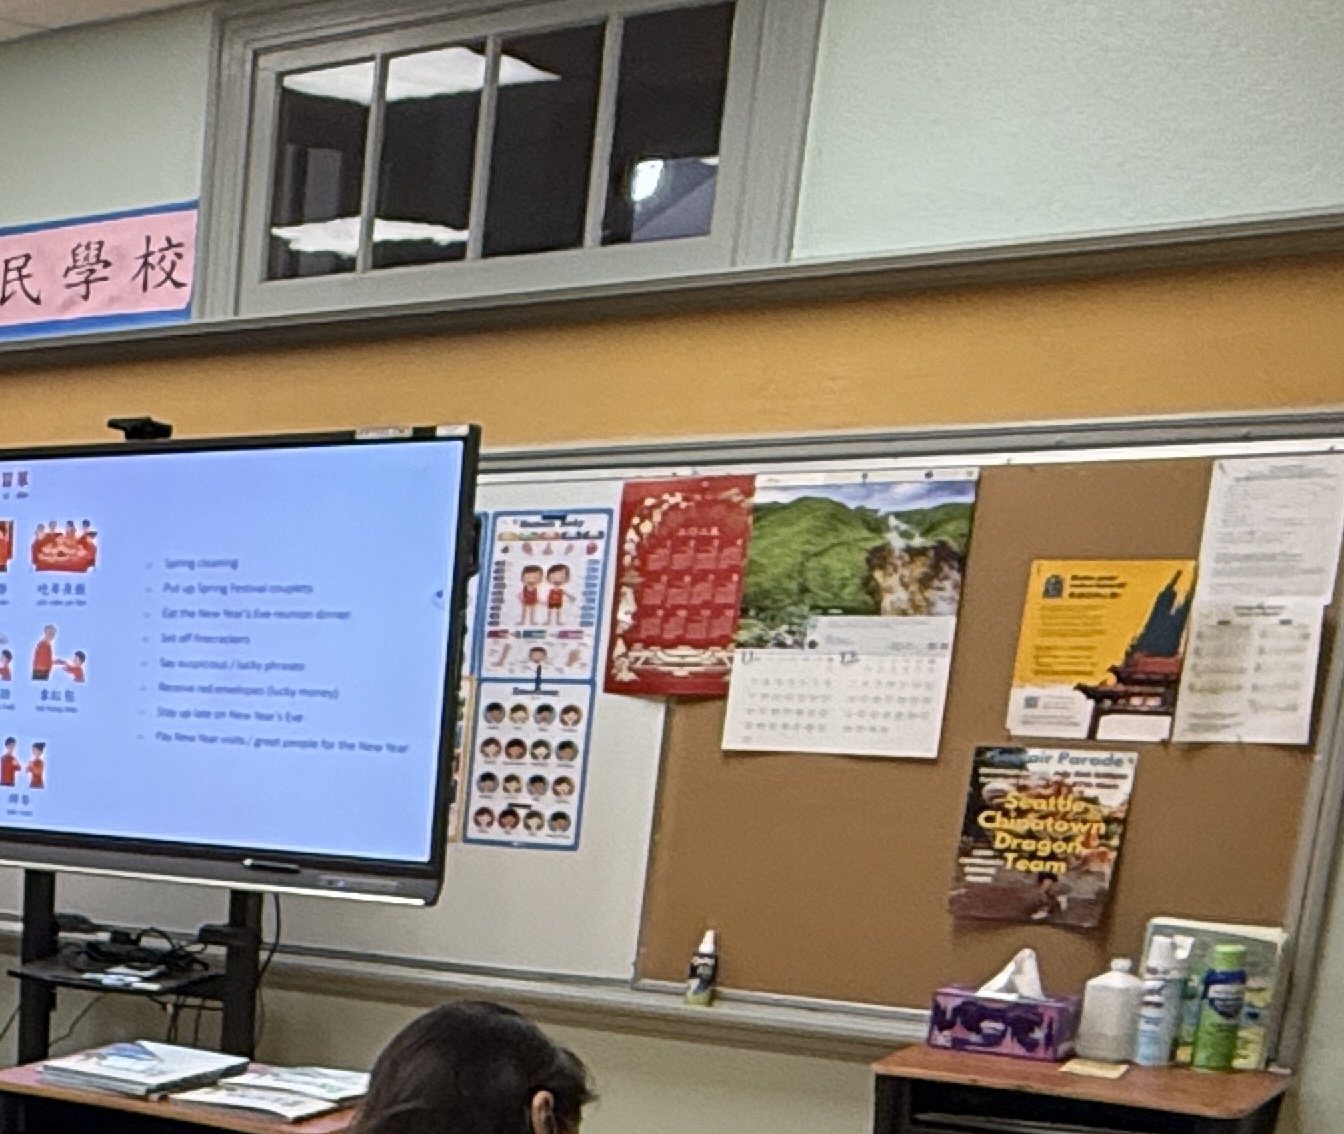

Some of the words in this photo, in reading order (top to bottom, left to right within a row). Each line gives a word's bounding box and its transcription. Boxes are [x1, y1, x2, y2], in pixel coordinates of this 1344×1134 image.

[164, 558, 195, 571] Spring
[197, 558, 239, 571] cleaning
[197, 583, 228, 596] Spring
[230, 583, 268, 593] Festival
[268, 584, 314, 595] couplets
[179, 608, 196, 618] the
[198, 609, 221, 618] New
[315, 609, 351, 619] dinner
[160, 633, 177, 643] Set
[236, 660, 263, 672] lucky
[264, 660, 305, 672] phrases
[196, 684, 214, 693] red
[298, 686, 340, 700] money)
[228, 710, 252, 720] New
[174, 732, 196, 742] New
[282, 739, 318, 750] people
[338, 740, 356, 750] the
[358, 741, 383, 752] New
[385, 742, 410, 754] Year
[1056, 751, 1125, 767] Parade
[1003, 791, 1088, 813] Seattle
[976, 810, 1107, 836] Chinatown
[993, 831, 1084, 856] Dragon
[1002, 852, 1068, 874] Team
